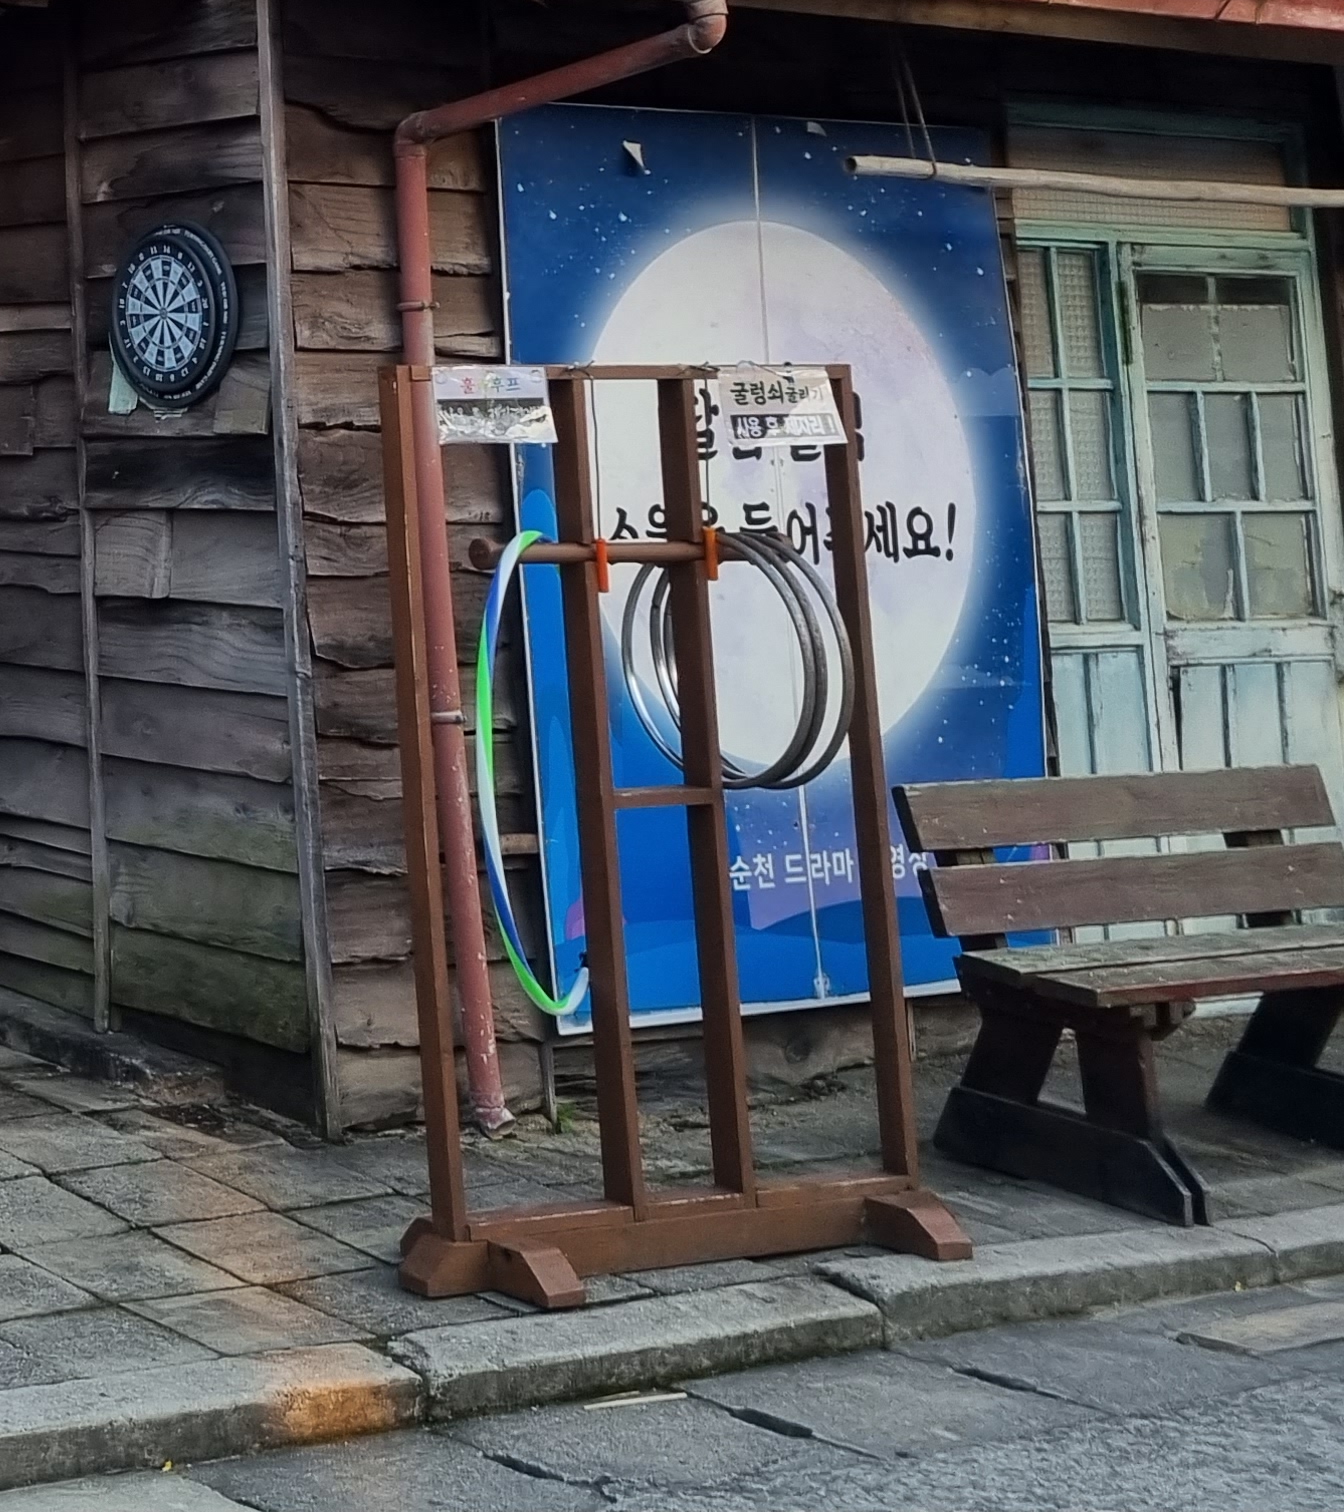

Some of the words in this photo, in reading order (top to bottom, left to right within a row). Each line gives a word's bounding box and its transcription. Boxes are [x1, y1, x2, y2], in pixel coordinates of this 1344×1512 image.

[730, 380, 785, 406] 굴렁쇠
[739, 501, 957, 565] 들어세요!
[729, 852, 776, 891] 순천
[784, 848, 854, 886] 드라마
